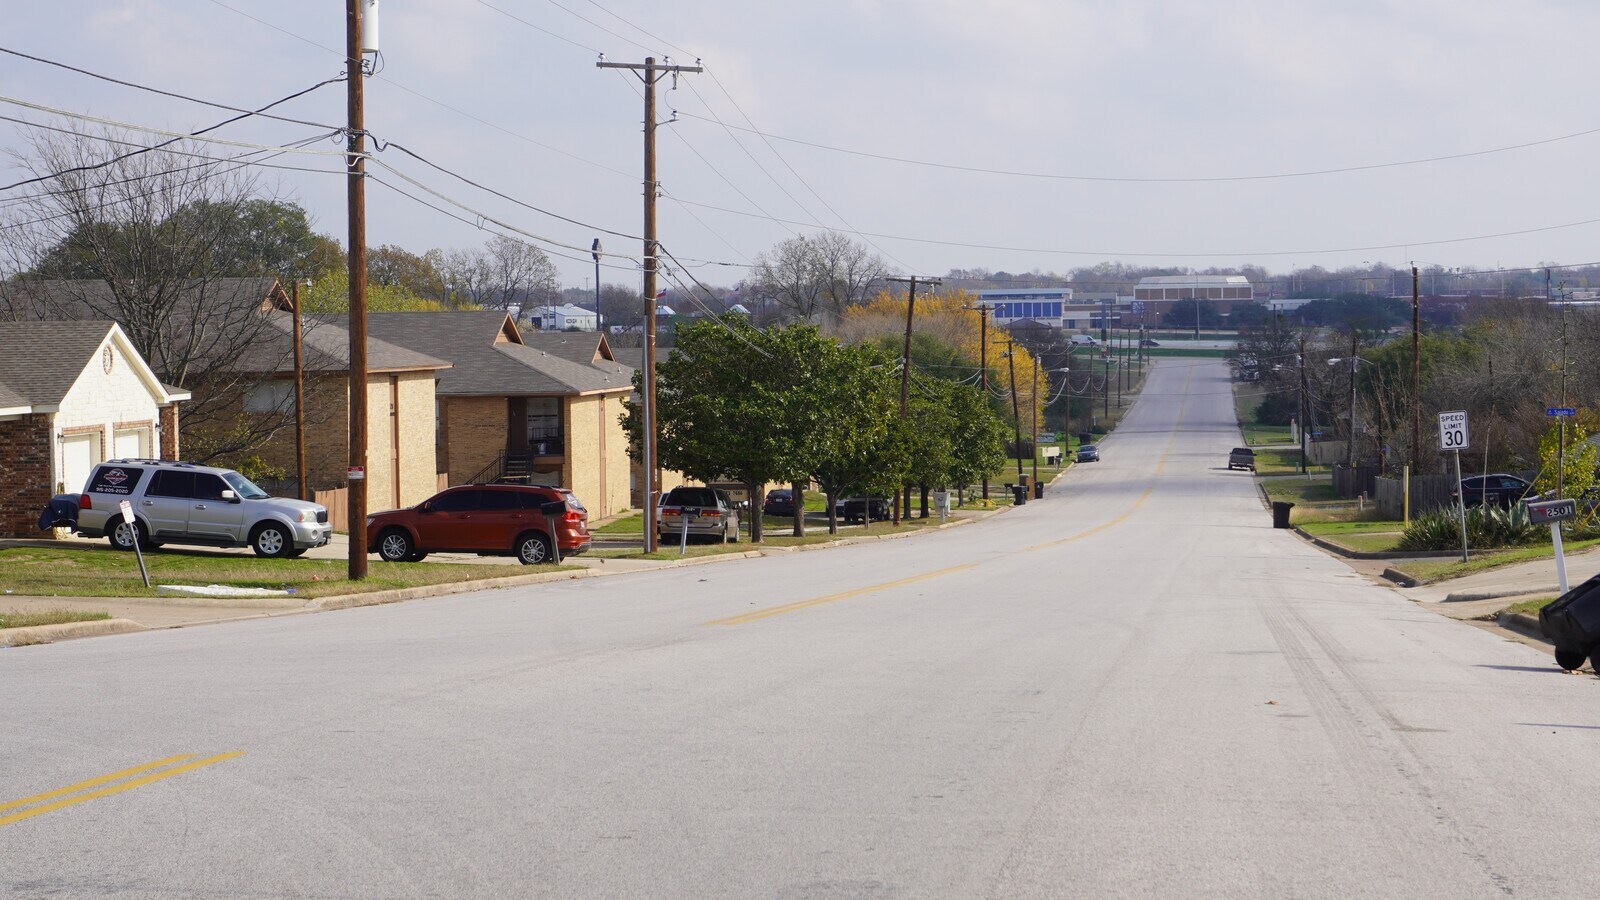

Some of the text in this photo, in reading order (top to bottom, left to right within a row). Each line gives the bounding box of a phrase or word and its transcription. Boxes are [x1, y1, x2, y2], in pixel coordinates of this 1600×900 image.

[1443, 422, 1462, 430] LIMIT
[1445, 430, 1463, 446] 30
[1547, 505, 1571, 517] 2501
